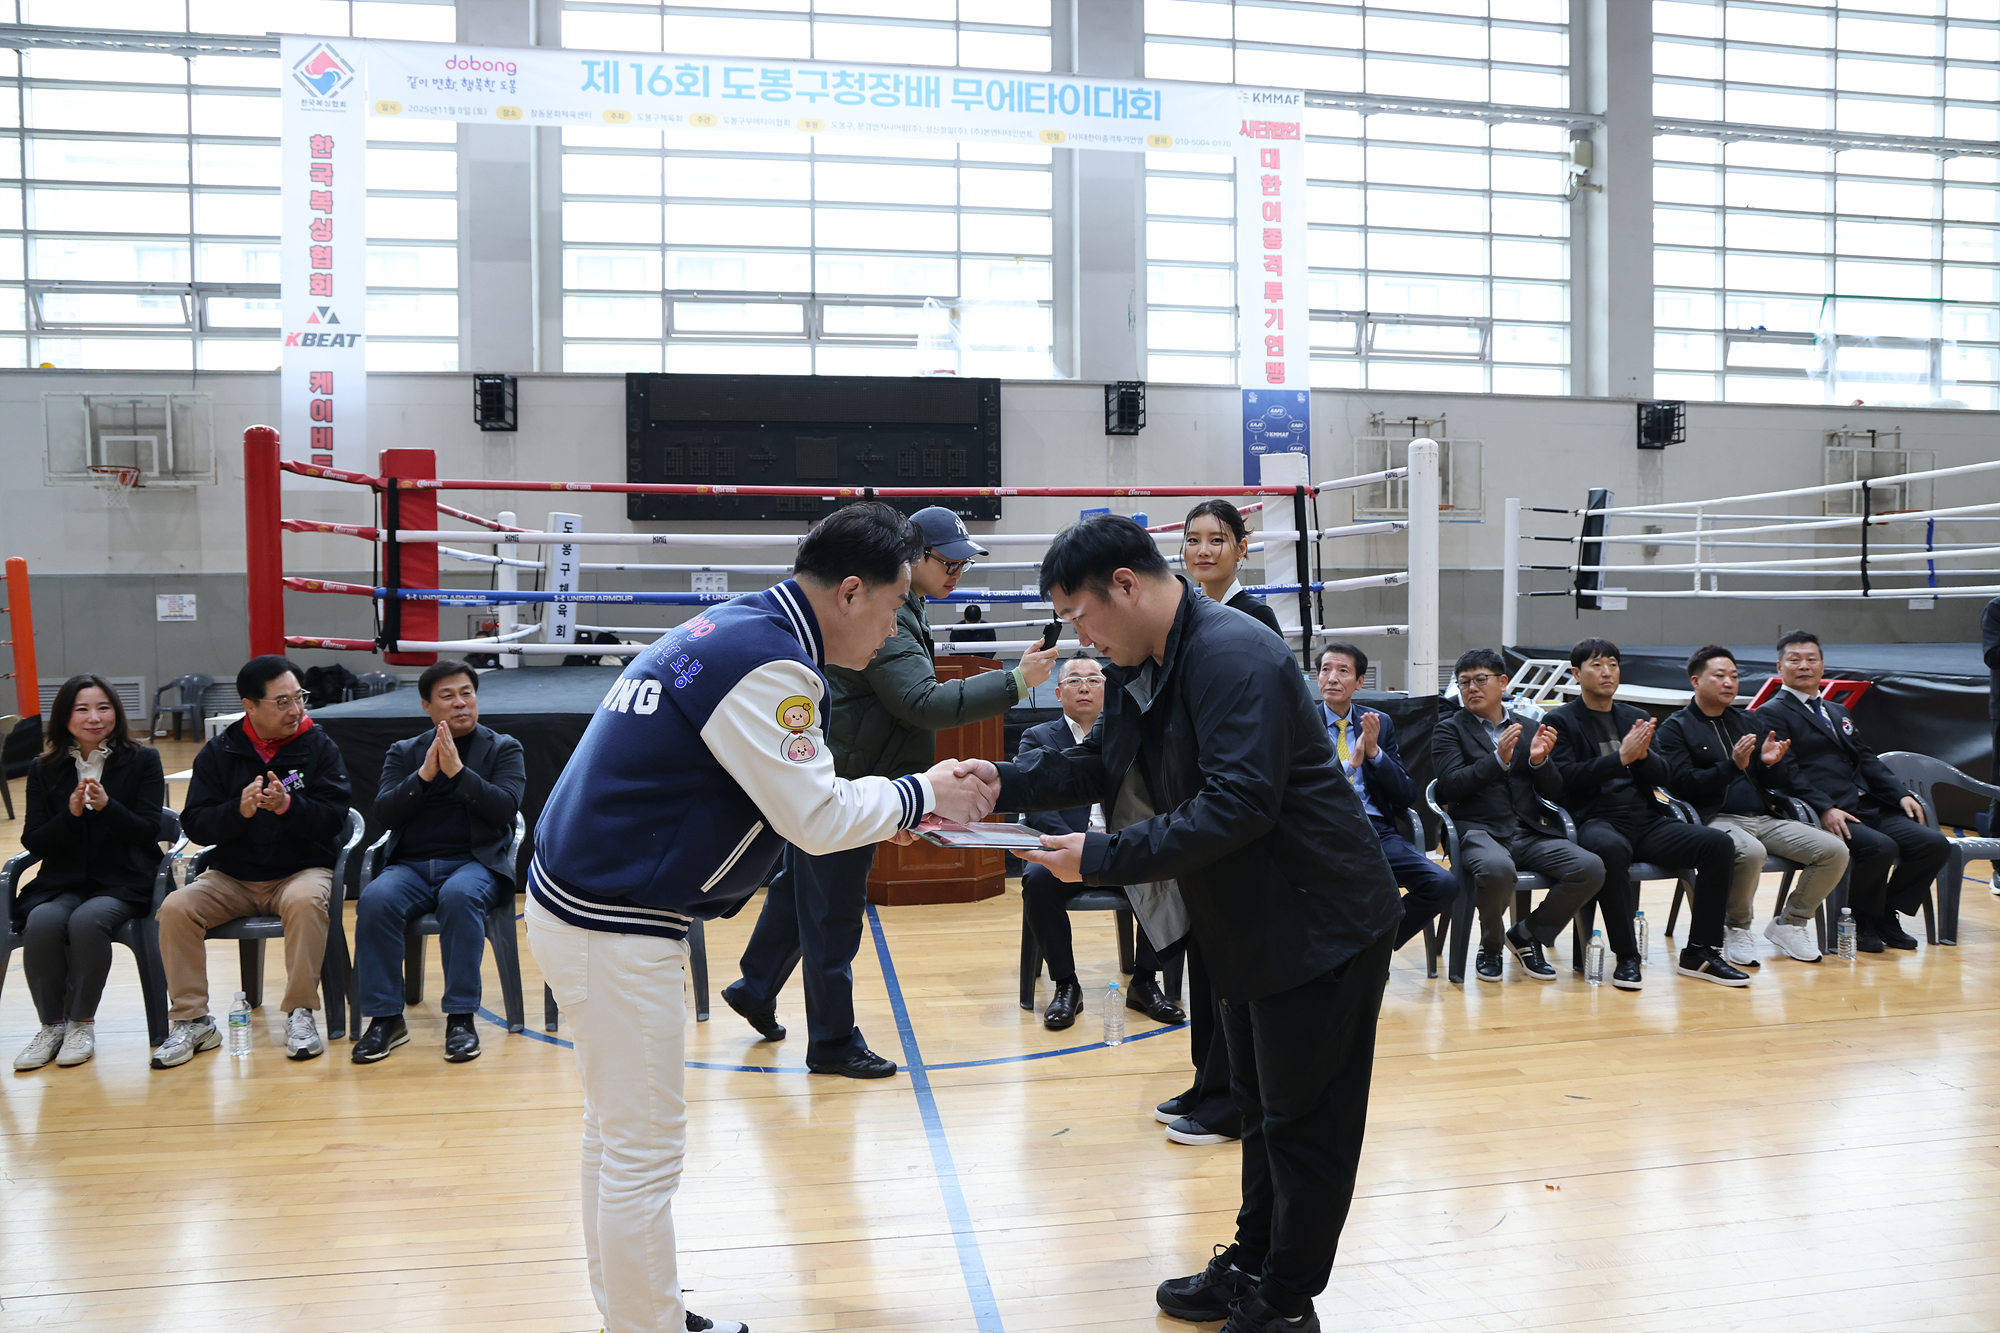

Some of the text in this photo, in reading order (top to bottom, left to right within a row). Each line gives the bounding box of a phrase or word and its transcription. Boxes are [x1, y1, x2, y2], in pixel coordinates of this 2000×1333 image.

[445, 54, 517, 76] dobong
[407, 76, 428, 89] 같이
[461, 77, 496, 93] 행복한
[500, 78, 517, 94] 도봉
[721, 65, 940, 108] 도봉구청장배
[951, 77, 1161, 121] 무에타이대회
[301, 98, 347, 108] 한국복싱협회
[1253, 92, 1300, 105] KMMAF
[381, 103, 397, 111] 일시
[473, 106, 487, 116] (토)
[502, 109, 517, 117] 장소
[610, 111, 625, 120] 주최
[637, 113, 683, 123] 도봉구체육회
[696, 115, 711, 124] 주관
[722, 116, 791, 127] 도봉구무에타이협회
[804, 120, 818, 129] 후원
[1239, 119, 1300, 140] 사단법인
[1154, 137, 1167, 145] 문의
[1175, 137, 1232, 147] 010-5004-0170
[309, 134, 334, 297] 한국복싱협회
[1260, 148, 1285, 384] 대한이종격투기연맹
[285, 332, 361, 347] KBEAT
[323, 470, 348, 481] Corona
[417, 479, 443, 488] Corona
[566, 482, 591, 490] Corona
[712, 485, 737, 494] Corona
[855, 487, 880, 496] Cona
[994, 488, 1018, 496] Corona
[333, 525, 358, 534] Corona
[505, 534, 520, 543] KING
[653, 535, 667, 544] KING
[322, 582, 348, 591] Corona
[322, 639, 347, 649] Corona
[670, 654, 703, 689] 도봉
